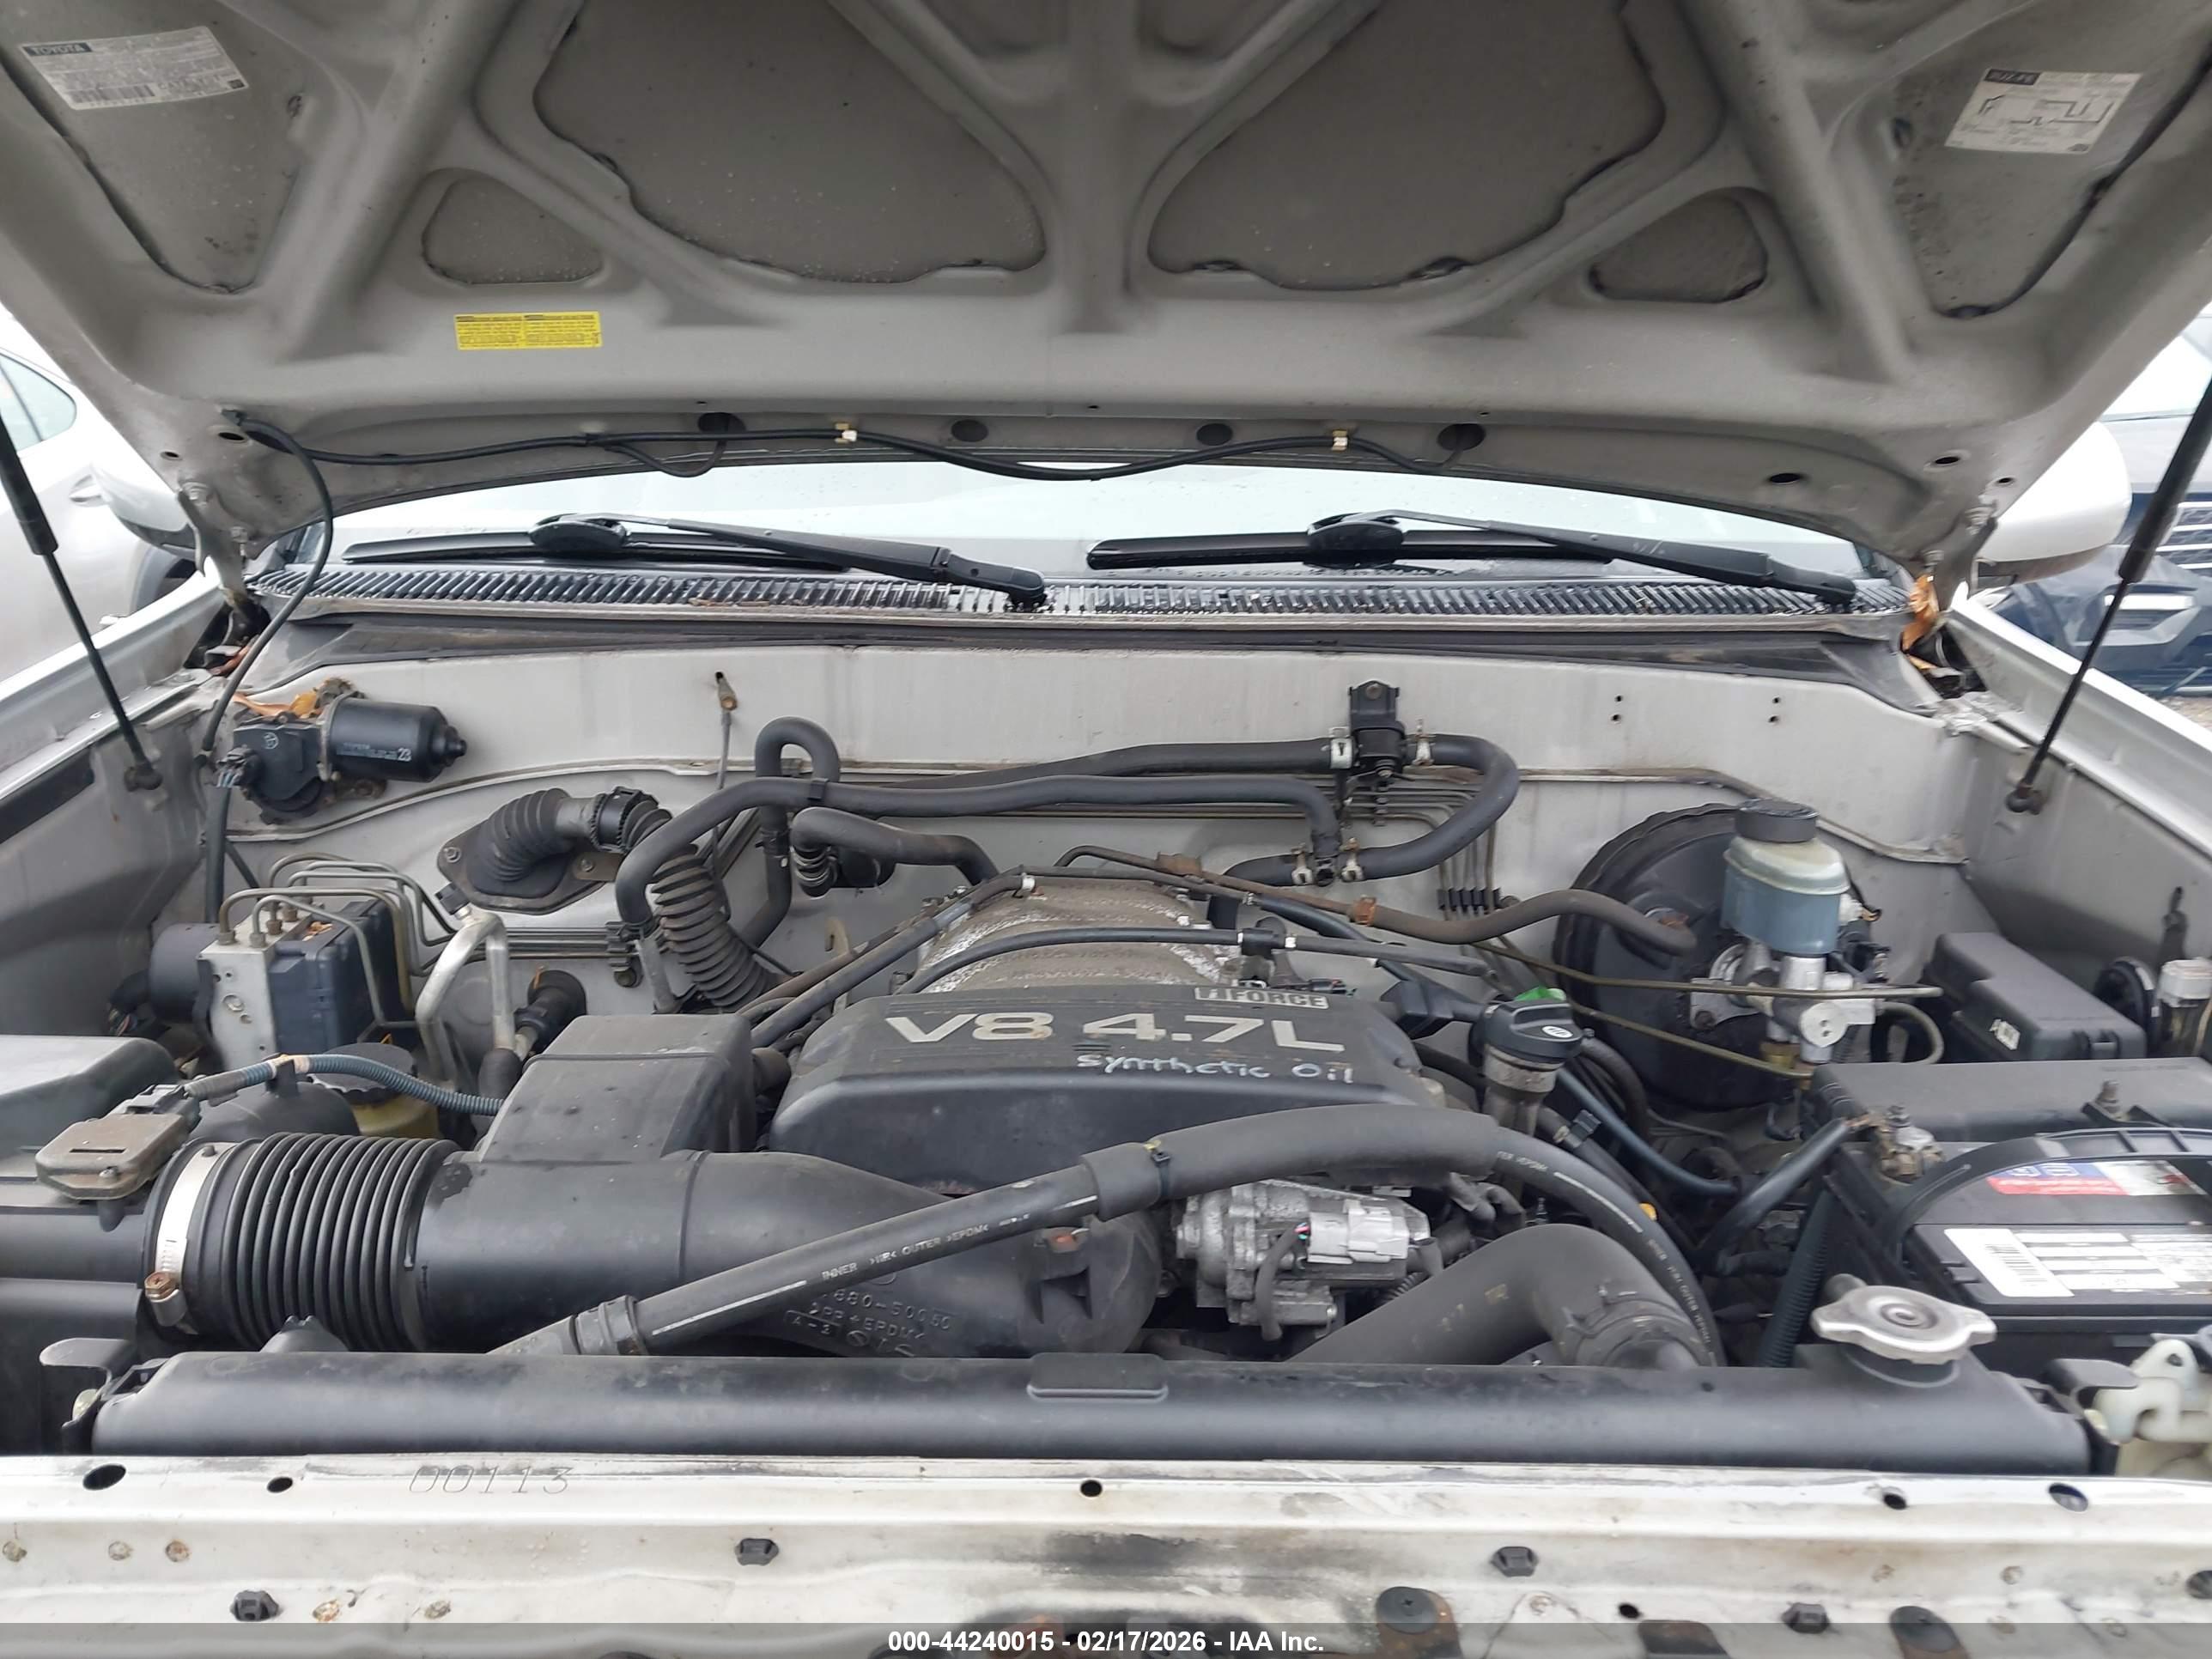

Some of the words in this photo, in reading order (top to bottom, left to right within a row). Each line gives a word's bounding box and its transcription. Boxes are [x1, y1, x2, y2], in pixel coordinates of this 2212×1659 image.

[30, 43, 85, 56] TOYOTA
[398, 747, 412, 763] 23
[885, 1012, 1054, 1044] V8
[1082, 1012, 1346, 1053] 4.7L
[1291, 1062, 1354, 1084] Oil
[901, 1236, 942, 1256] OUTER
[823, 1288, 952, 1330] 880-50050
[408, 1464, 574, 1495] 00113
